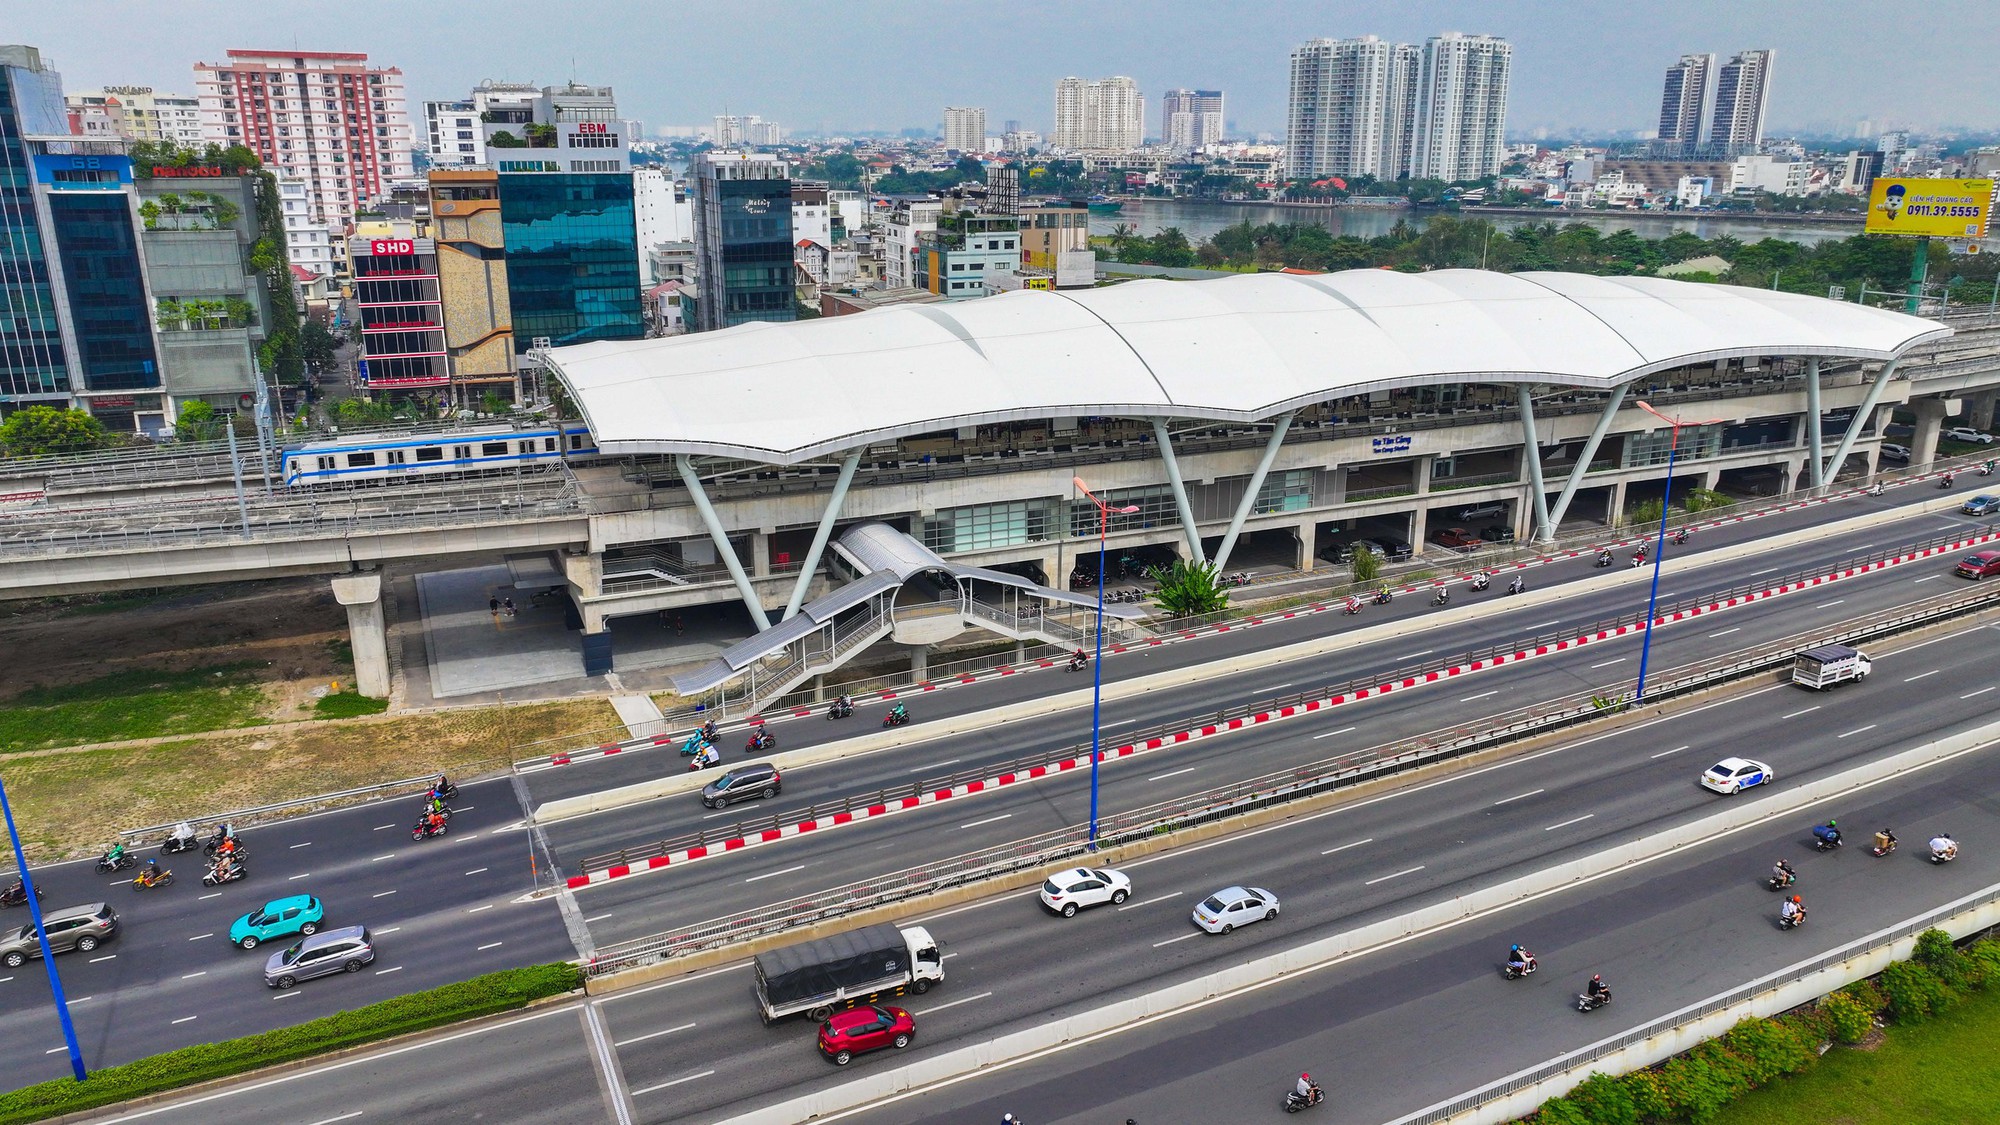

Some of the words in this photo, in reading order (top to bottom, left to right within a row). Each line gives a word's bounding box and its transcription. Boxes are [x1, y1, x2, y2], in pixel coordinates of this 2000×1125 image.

[579, 123, 607, 134] EBM
[1907, 205, 1980, 217] 0911.39.5555
[376, 242, 410, 254] SHD
